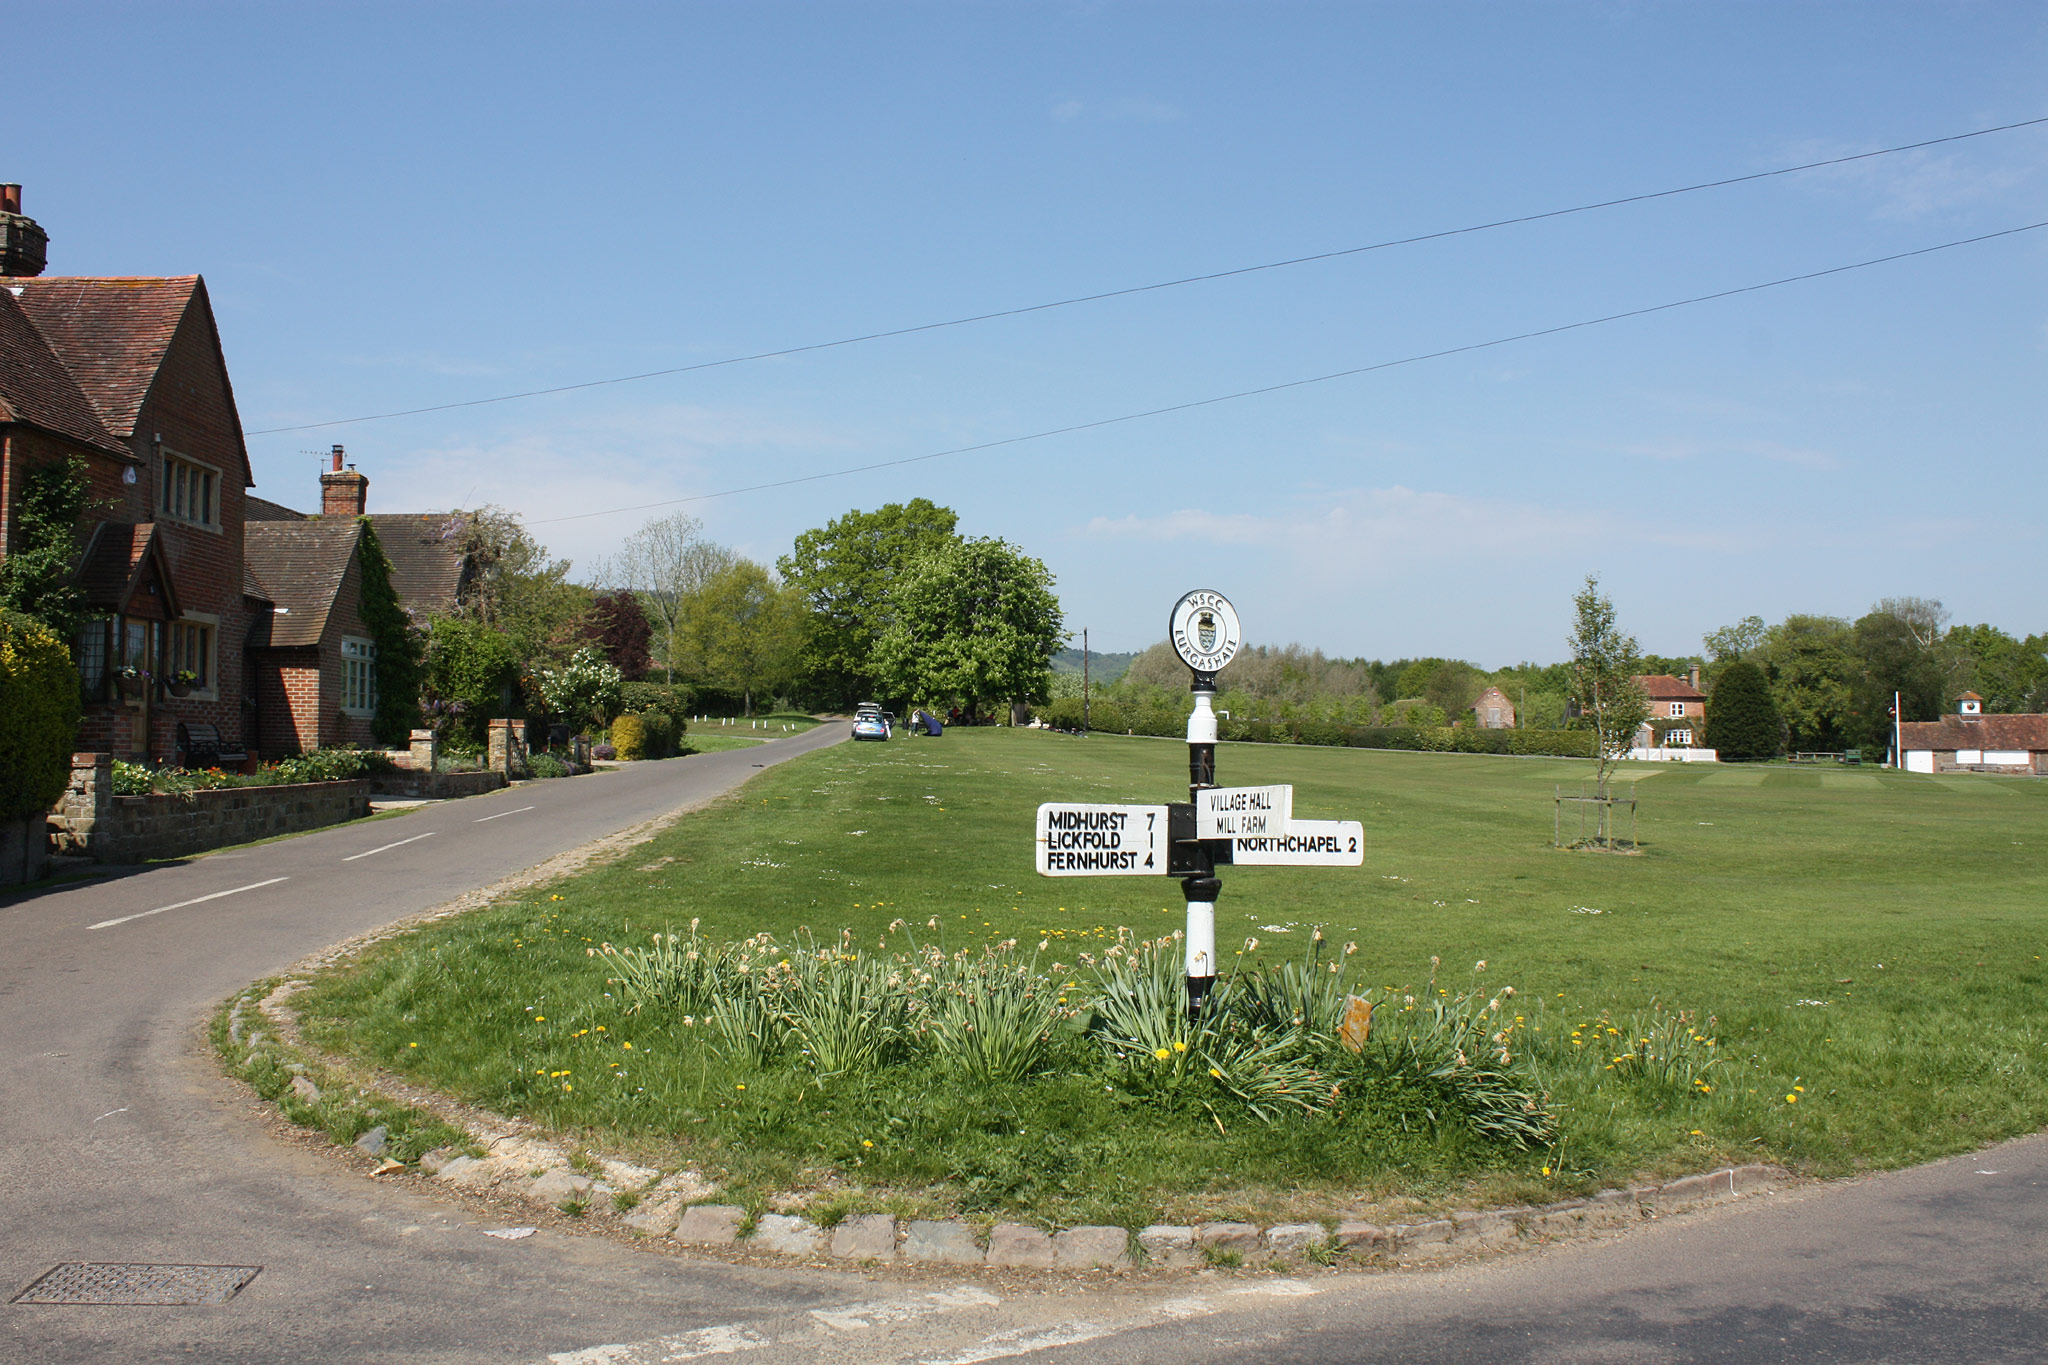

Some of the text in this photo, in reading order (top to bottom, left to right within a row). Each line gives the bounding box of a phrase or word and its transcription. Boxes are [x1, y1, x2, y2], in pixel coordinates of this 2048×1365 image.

[1188, 594, 1224, 611] WSCC
[1175, 630, 1237, 669] LURGASHALL
[1210, 792, 1272, 812] VILLAGE HALL
[1048, 811, 1155, 831] MIDHURST 7
[1216, 816, 1266, 834] MILL FARM
[1048, 831, 1121, 850] LICKFOLD
[1237, 836, 1357, 853] NORTHCHAPEL 2
[1047, 851, 1153, 870] FERNHURST 4
